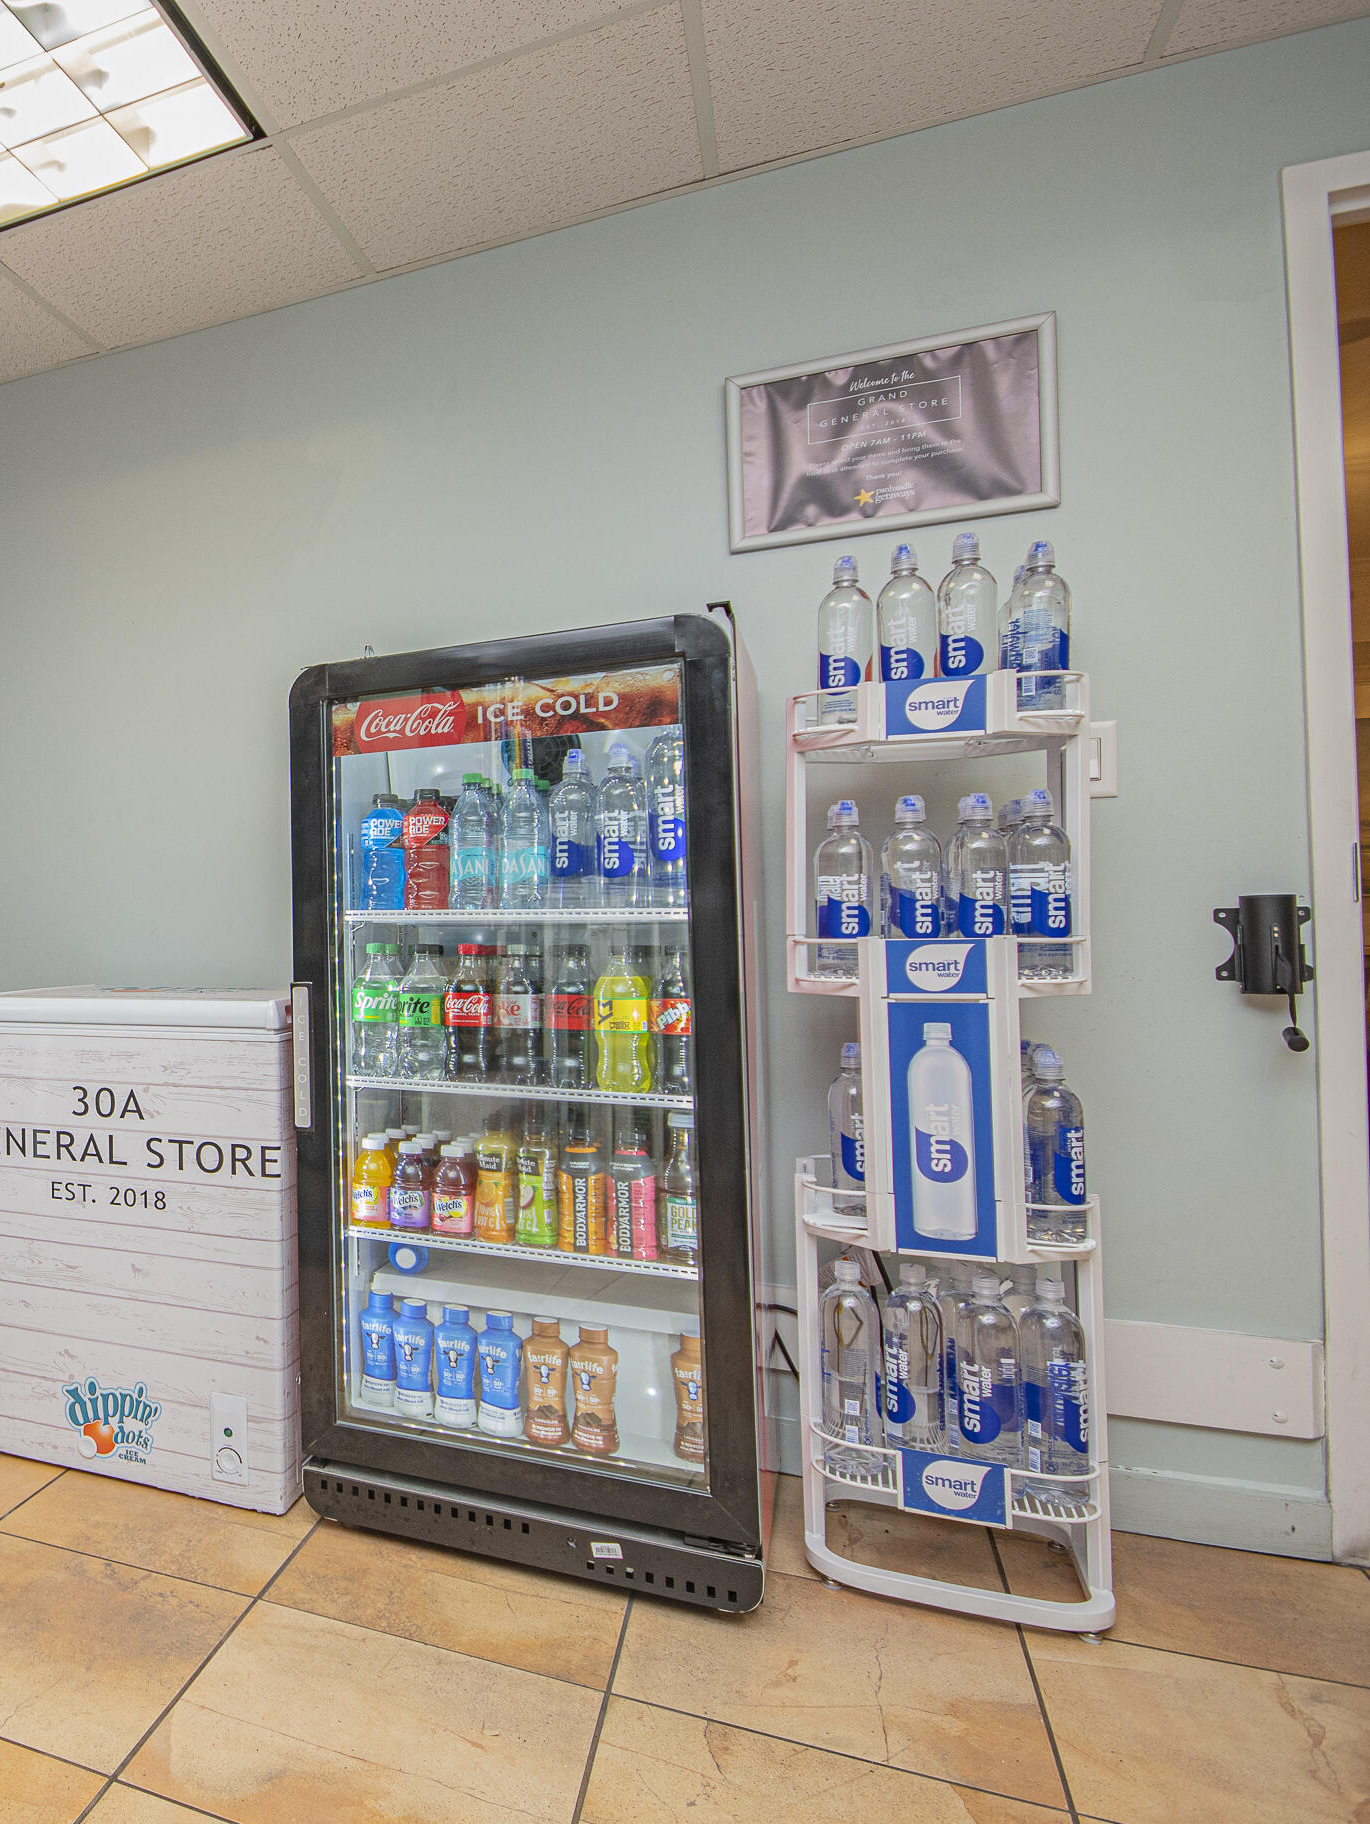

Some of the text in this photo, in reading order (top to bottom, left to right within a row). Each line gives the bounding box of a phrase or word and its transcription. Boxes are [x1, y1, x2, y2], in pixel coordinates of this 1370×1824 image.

[849, 369, 915, 392] Welcome to the
[857, 390, 909, 406] GRAND
[819, 397, 949, 428] GENERAL STORE
[841, 440, 867, 451] OPEN
[870, 436, 891, 447] 7AM
[901, 431, 927, 441] 11PM
[967, 603, 977, 631] water
[888, 612, 908, 680] smart
[947, 602, 966, 669] smart
[827, 621, 845, 688] smart
[477, 691, 619, 724] ICE COLD
[908, 696, 960, 713] smart
[936, 708, 960, 718] water
[360, 699, 461, 742] Coca-Cola
[409, 816, 446, 826] POWER
[409, 825, 430, 834] ADE
[569, 810, 578, 836] water
[619, 809, 629, 836] water
[654, 784, 676, 851] smart
[370, 828, 391, 836] ADE
[555, 811, 568, 869] smart
[604, 809, 620, 870] smart
[450, 853, 489, 879] ASANI
[502, 853, 545, 879] DASAN
[995, 870, 1004, 900] water
[1044, 863, 1066, 929] smart
[841, 873, 859, 935] smart
[912, 871, 932, 934] smart
[972, 870, 995, 935] smart
[908, 959, 961, 973] smart
[937, 970, 961, 979] water
[399, 996, 430, 1015] rite
[444, 994, 489, 1014] Coca-Cola
[297, 998, 308, 1117] ICE COLD
[71, 1085, 146, 1121] 30A
[925, 1103, 952, 1173] smart
[145, 1137, 282, 1179] STORE
[1067, 1129, 1086, 1196] smart
[50, 1181, 167, 1211] EST. 2018
[435, 1200, 462, 1213] Welch's
[574, 1177, 587, 1247] BODYARMOR
[617, 1181, 632, 1253] BODYARMOR
[361, 1320, 392, 1335] fairlife
[394, 1331, 426, 1346] fairlife
[437, 1337, 471, 1352] fairlife
[527, 1351, 563, 1366] fairlife
[674, 1367, 702, 1380] fairli
[883, 1342, 898, 1413] smart
[898, 1349, 909, 1380] water
[980, 1365, 992, 1398] water
[64, 1380, 159, 1427] dippin'
[960, 1360, 981, 1433] smart
[114, 1424, 151, 1450] dots
[118, 1453, 147, 1465] CREAM
[125, 1449, 139, 1458] ICE
[924, 1473, 978, 1494] smart
[953, 1490, 977, 1500] water
